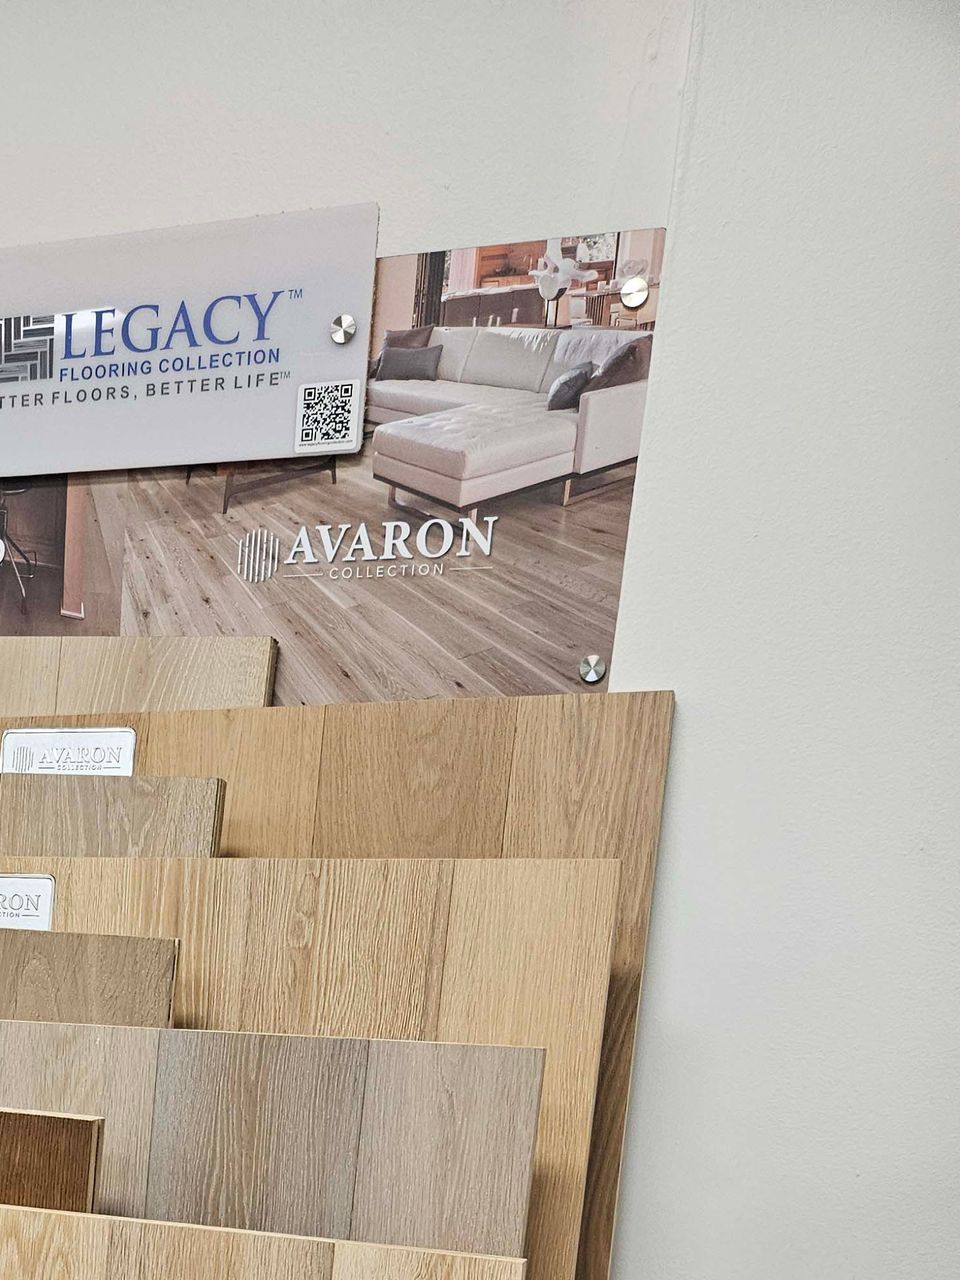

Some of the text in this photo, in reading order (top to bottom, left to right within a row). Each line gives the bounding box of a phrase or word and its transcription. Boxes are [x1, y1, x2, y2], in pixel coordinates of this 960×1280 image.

[61, 290, 285, 360] LEGACY
[60, 348, 280, 382] FLOORING COLLECTION
[52, 385, 138, 405] FLOORS,
[145, 376, 225, 397] BETTER
[284, 516, 499, 565] AVARON
[329, 563, 445, 579] COLLECTION
[38, 746, 123, 764] AVARON
